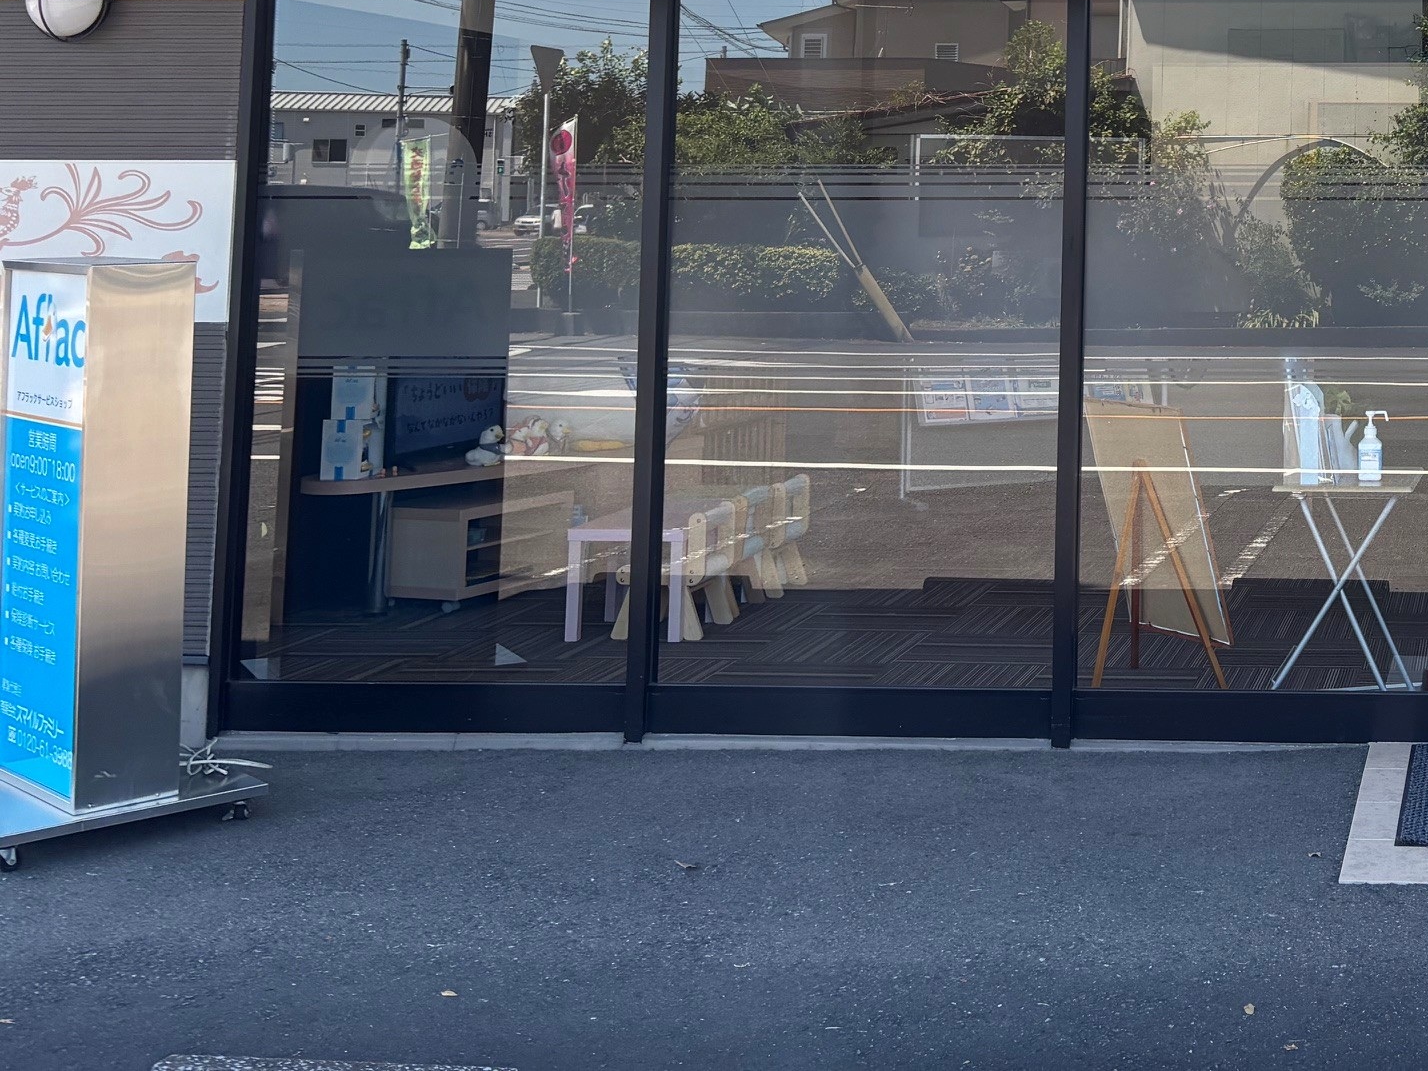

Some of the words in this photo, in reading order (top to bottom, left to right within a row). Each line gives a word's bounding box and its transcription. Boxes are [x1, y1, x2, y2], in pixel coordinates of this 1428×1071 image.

[17, 390, 73, 409] アフラックサービスショップ
